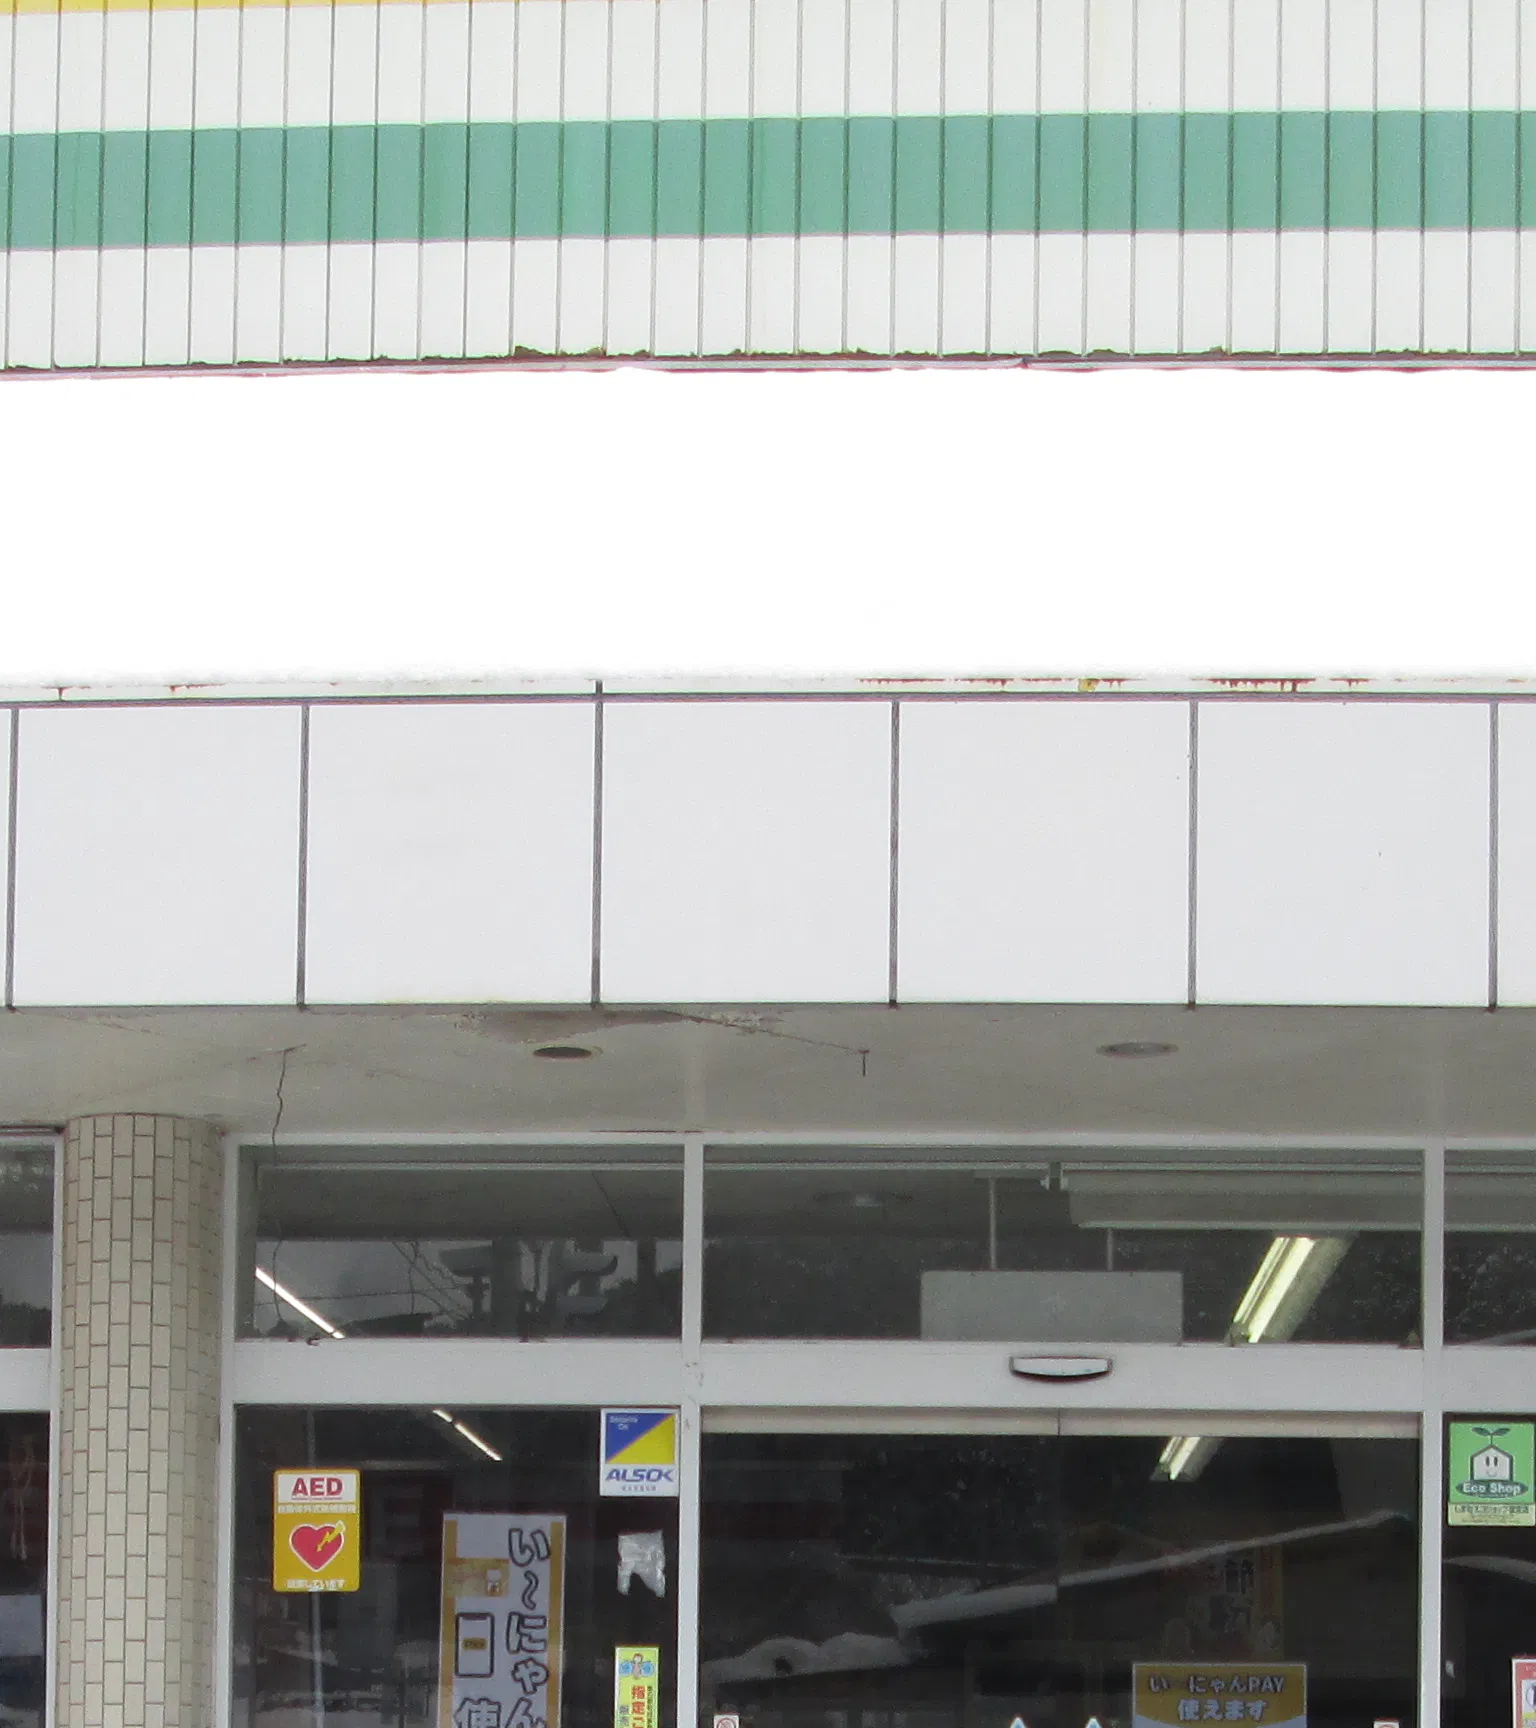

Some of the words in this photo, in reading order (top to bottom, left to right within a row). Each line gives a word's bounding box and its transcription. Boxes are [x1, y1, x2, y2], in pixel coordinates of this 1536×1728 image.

[605, 1467, 674, 1483] ALSOK
[291, 1476, 344, 1497] AED
[1462, 1483, 1486, 1493] Eco
[1490, 1483, 1521, 1495] Shop
[1176, 1699, 1269, 1722] 使えます
